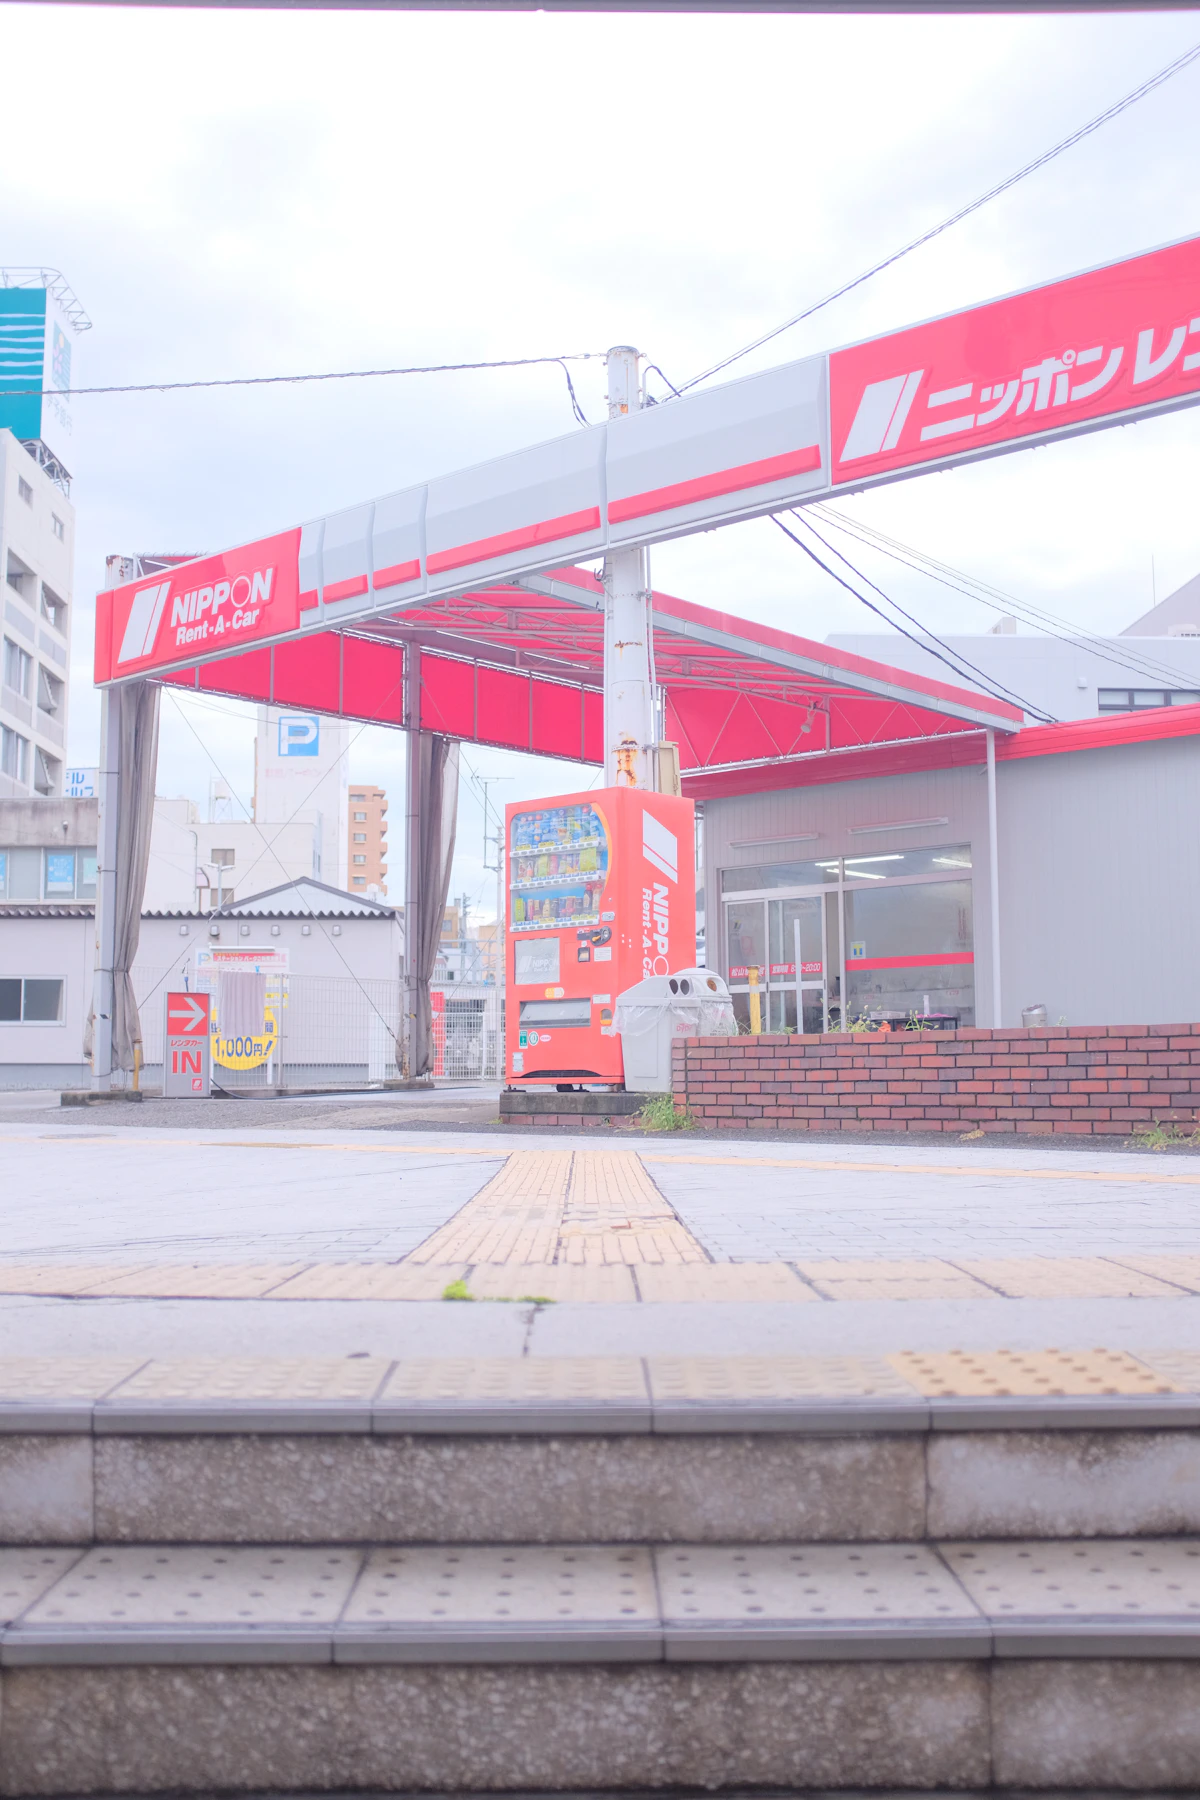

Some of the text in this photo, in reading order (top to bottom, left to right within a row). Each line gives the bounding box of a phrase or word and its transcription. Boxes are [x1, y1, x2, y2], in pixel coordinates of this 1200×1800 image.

[170, 567, 274, 628] NIPPON
[175, 608, 260, 647] Rent-A-Car
[280, 718, 318, 755] P
[642, 887, 653, 980] Rent-A-Ca
[653, 881, 670, 976] NIPPO
[170, 1039, 204, 1047] レンタカー
[172, 1050, 202, 1074] IN
